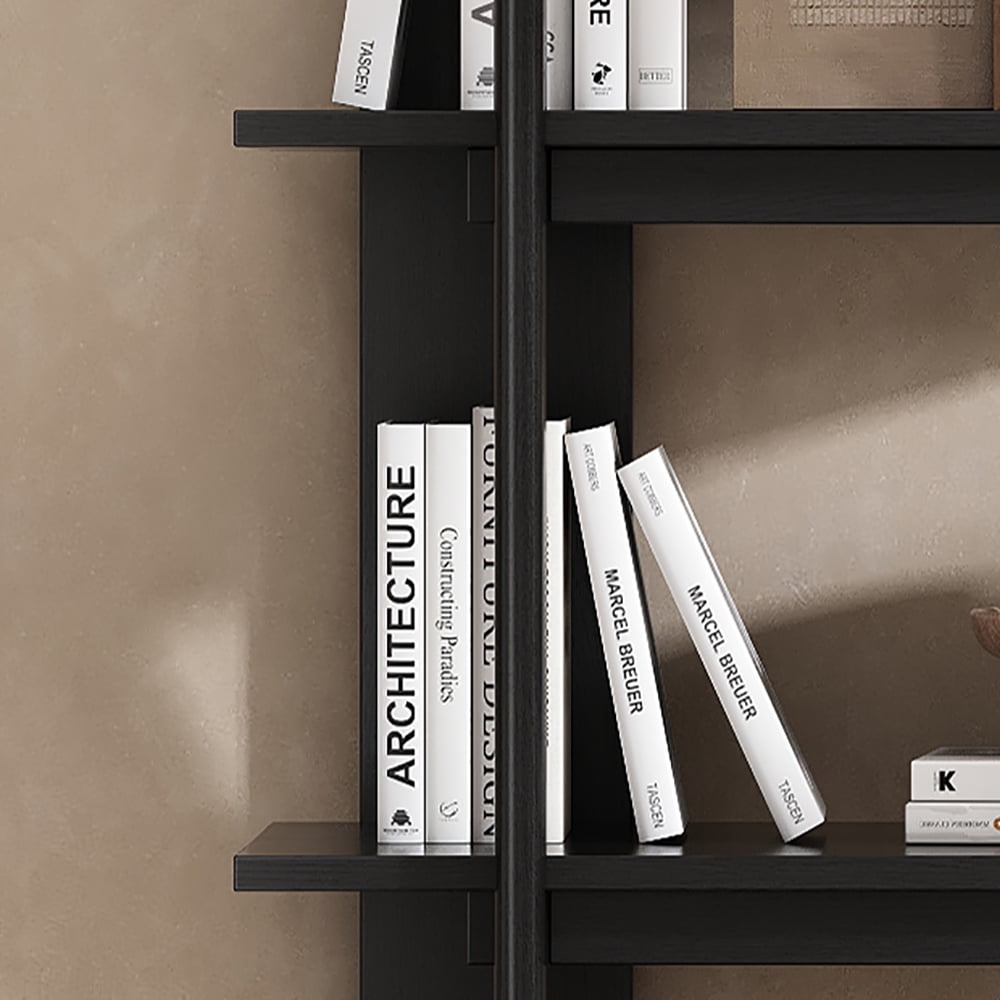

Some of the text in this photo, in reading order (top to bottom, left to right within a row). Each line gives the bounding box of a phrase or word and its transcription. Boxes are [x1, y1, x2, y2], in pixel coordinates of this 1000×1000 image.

[353, 39, 375, 96] TASCEN
[386, 466, 416, 788] ARCHITECTURE
[435, 526, 459, 704] Constructing Paradies
[604, 568, 644, 715] MARCEL BREUER
[687, 584, 758, 721] MARCEL BREUER
[646, 781, 664, 829] TASCEN
[777, 778, 805, 825] TASCEN
[938, 770, 956, 791] K
